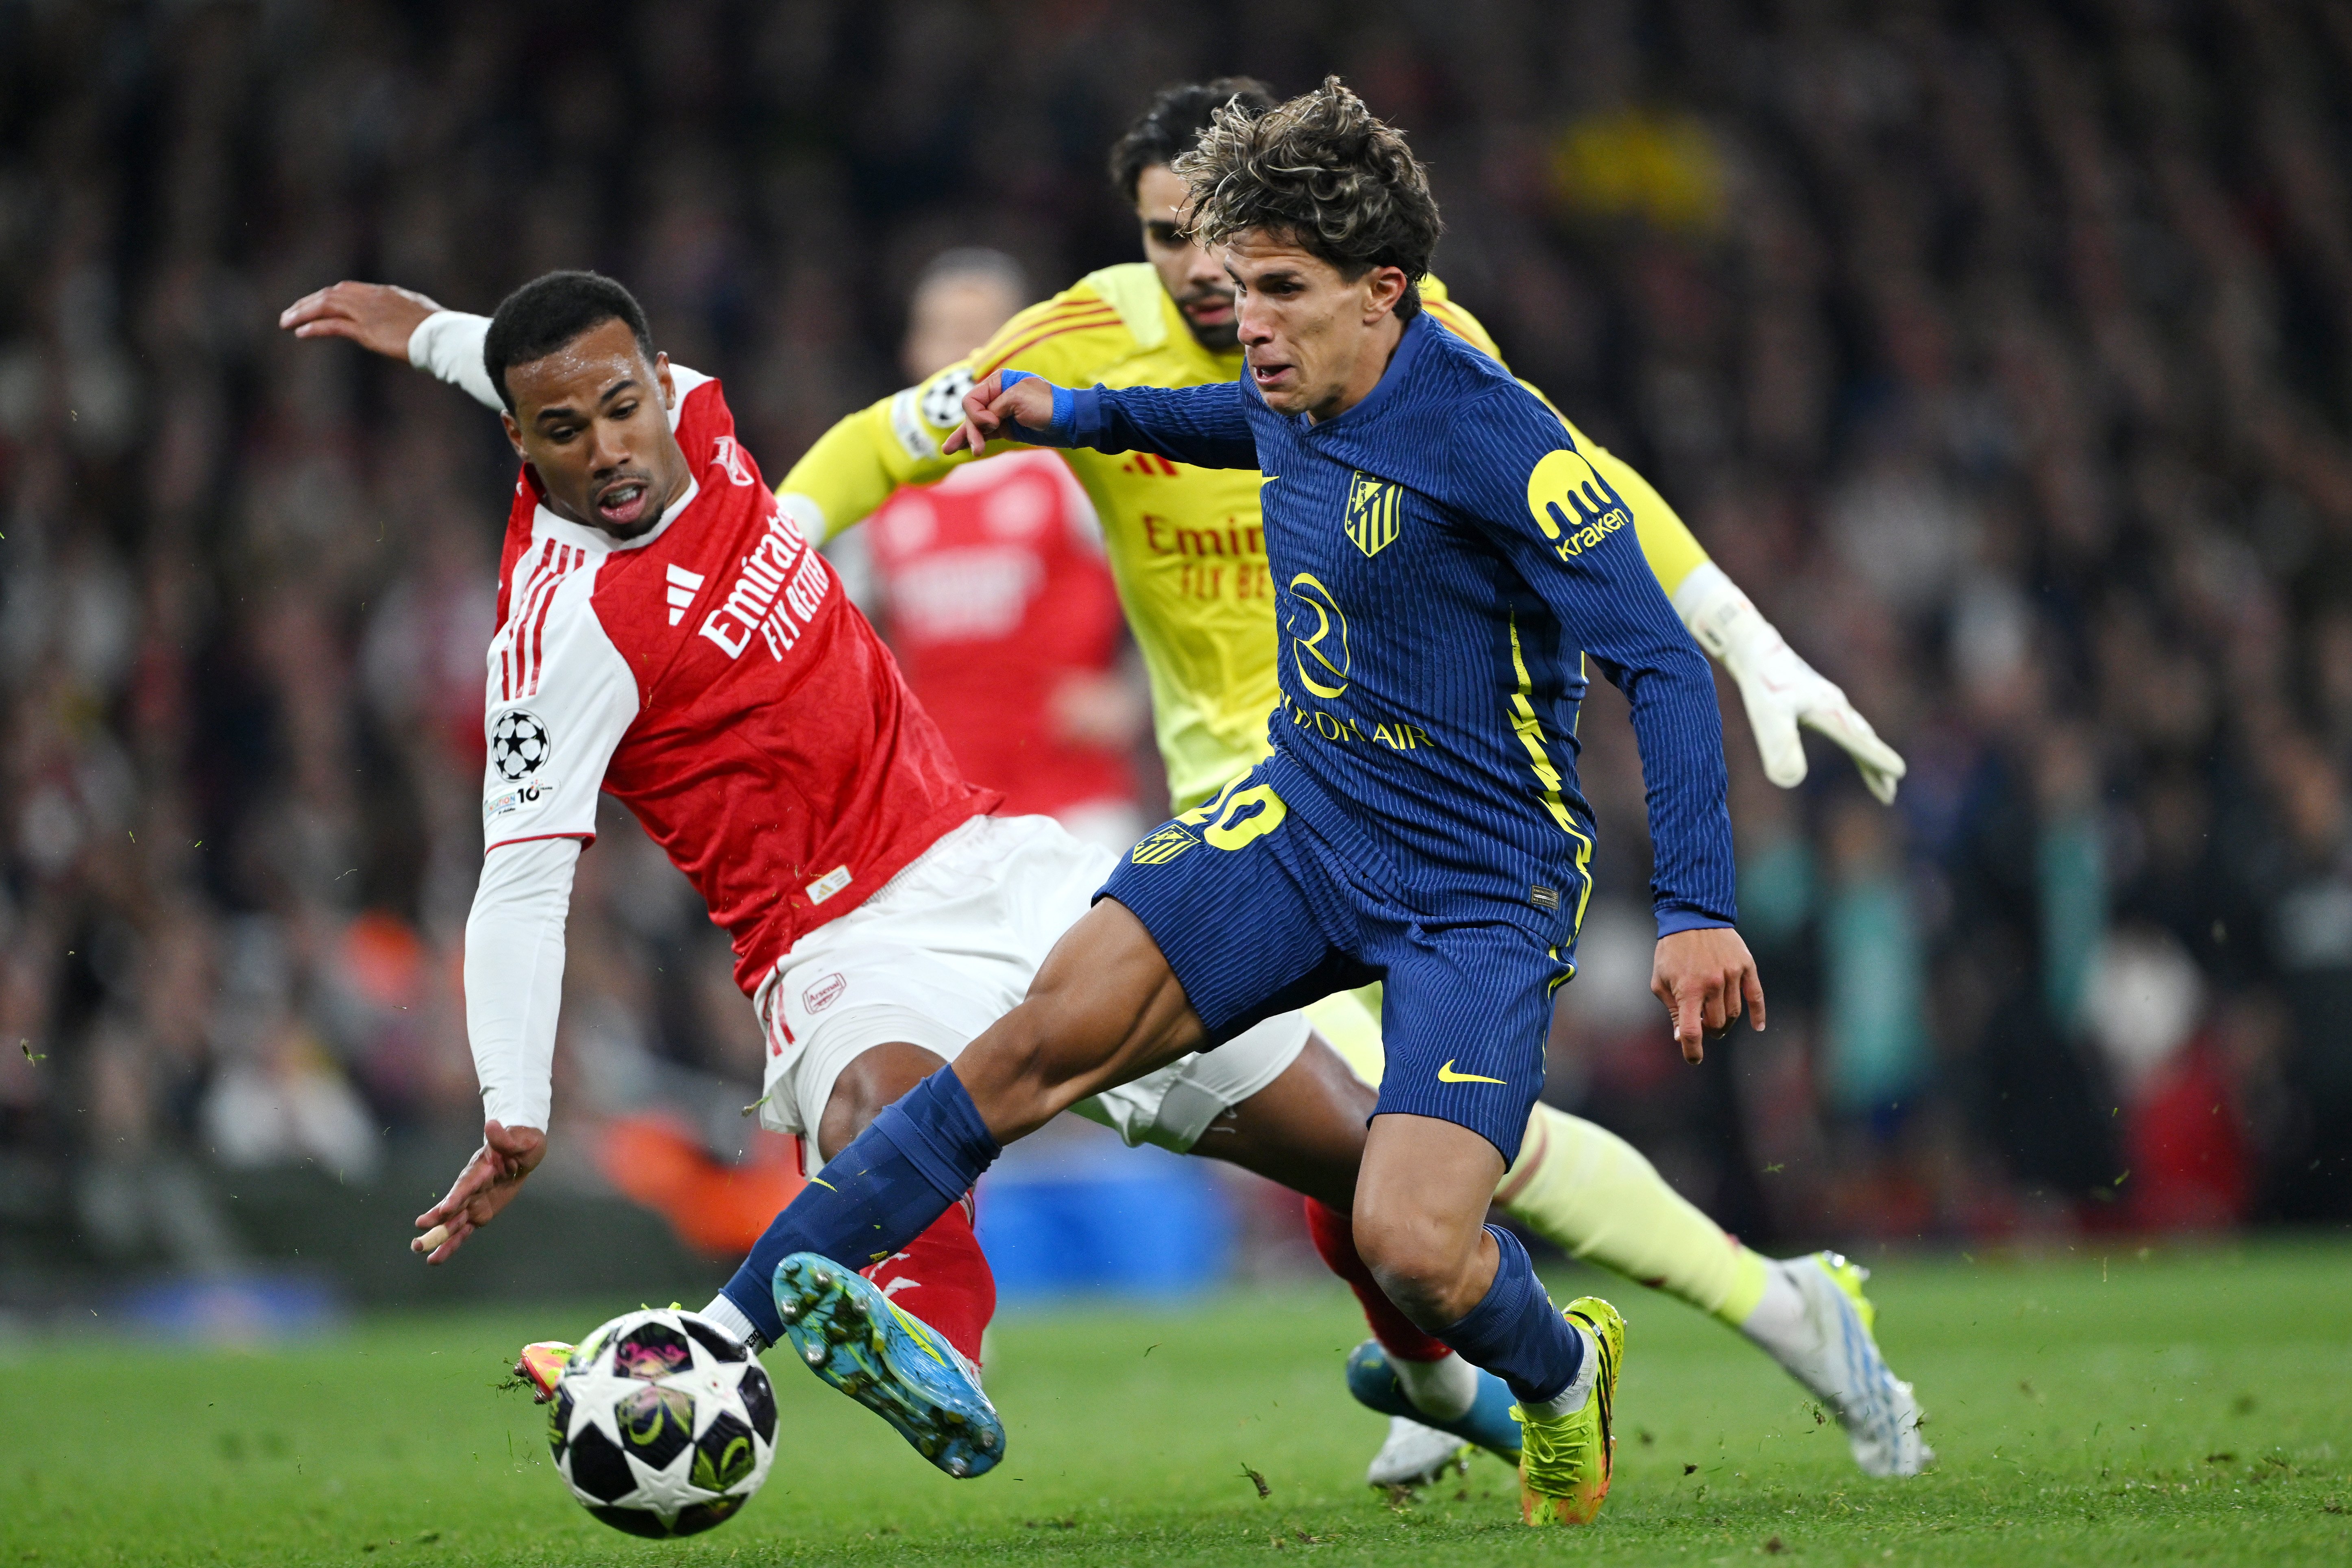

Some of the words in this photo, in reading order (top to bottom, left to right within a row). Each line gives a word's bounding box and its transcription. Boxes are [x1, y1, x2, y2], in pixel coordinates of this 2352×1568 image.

[1143, 513, 1263, 557] Emir
[1555, 508, 1629, 562] kraken
[698, 507, 804, 660] Emirate
[760, 599, 800, 662] FLY
[1373, 723, 1435, 750] AIR
